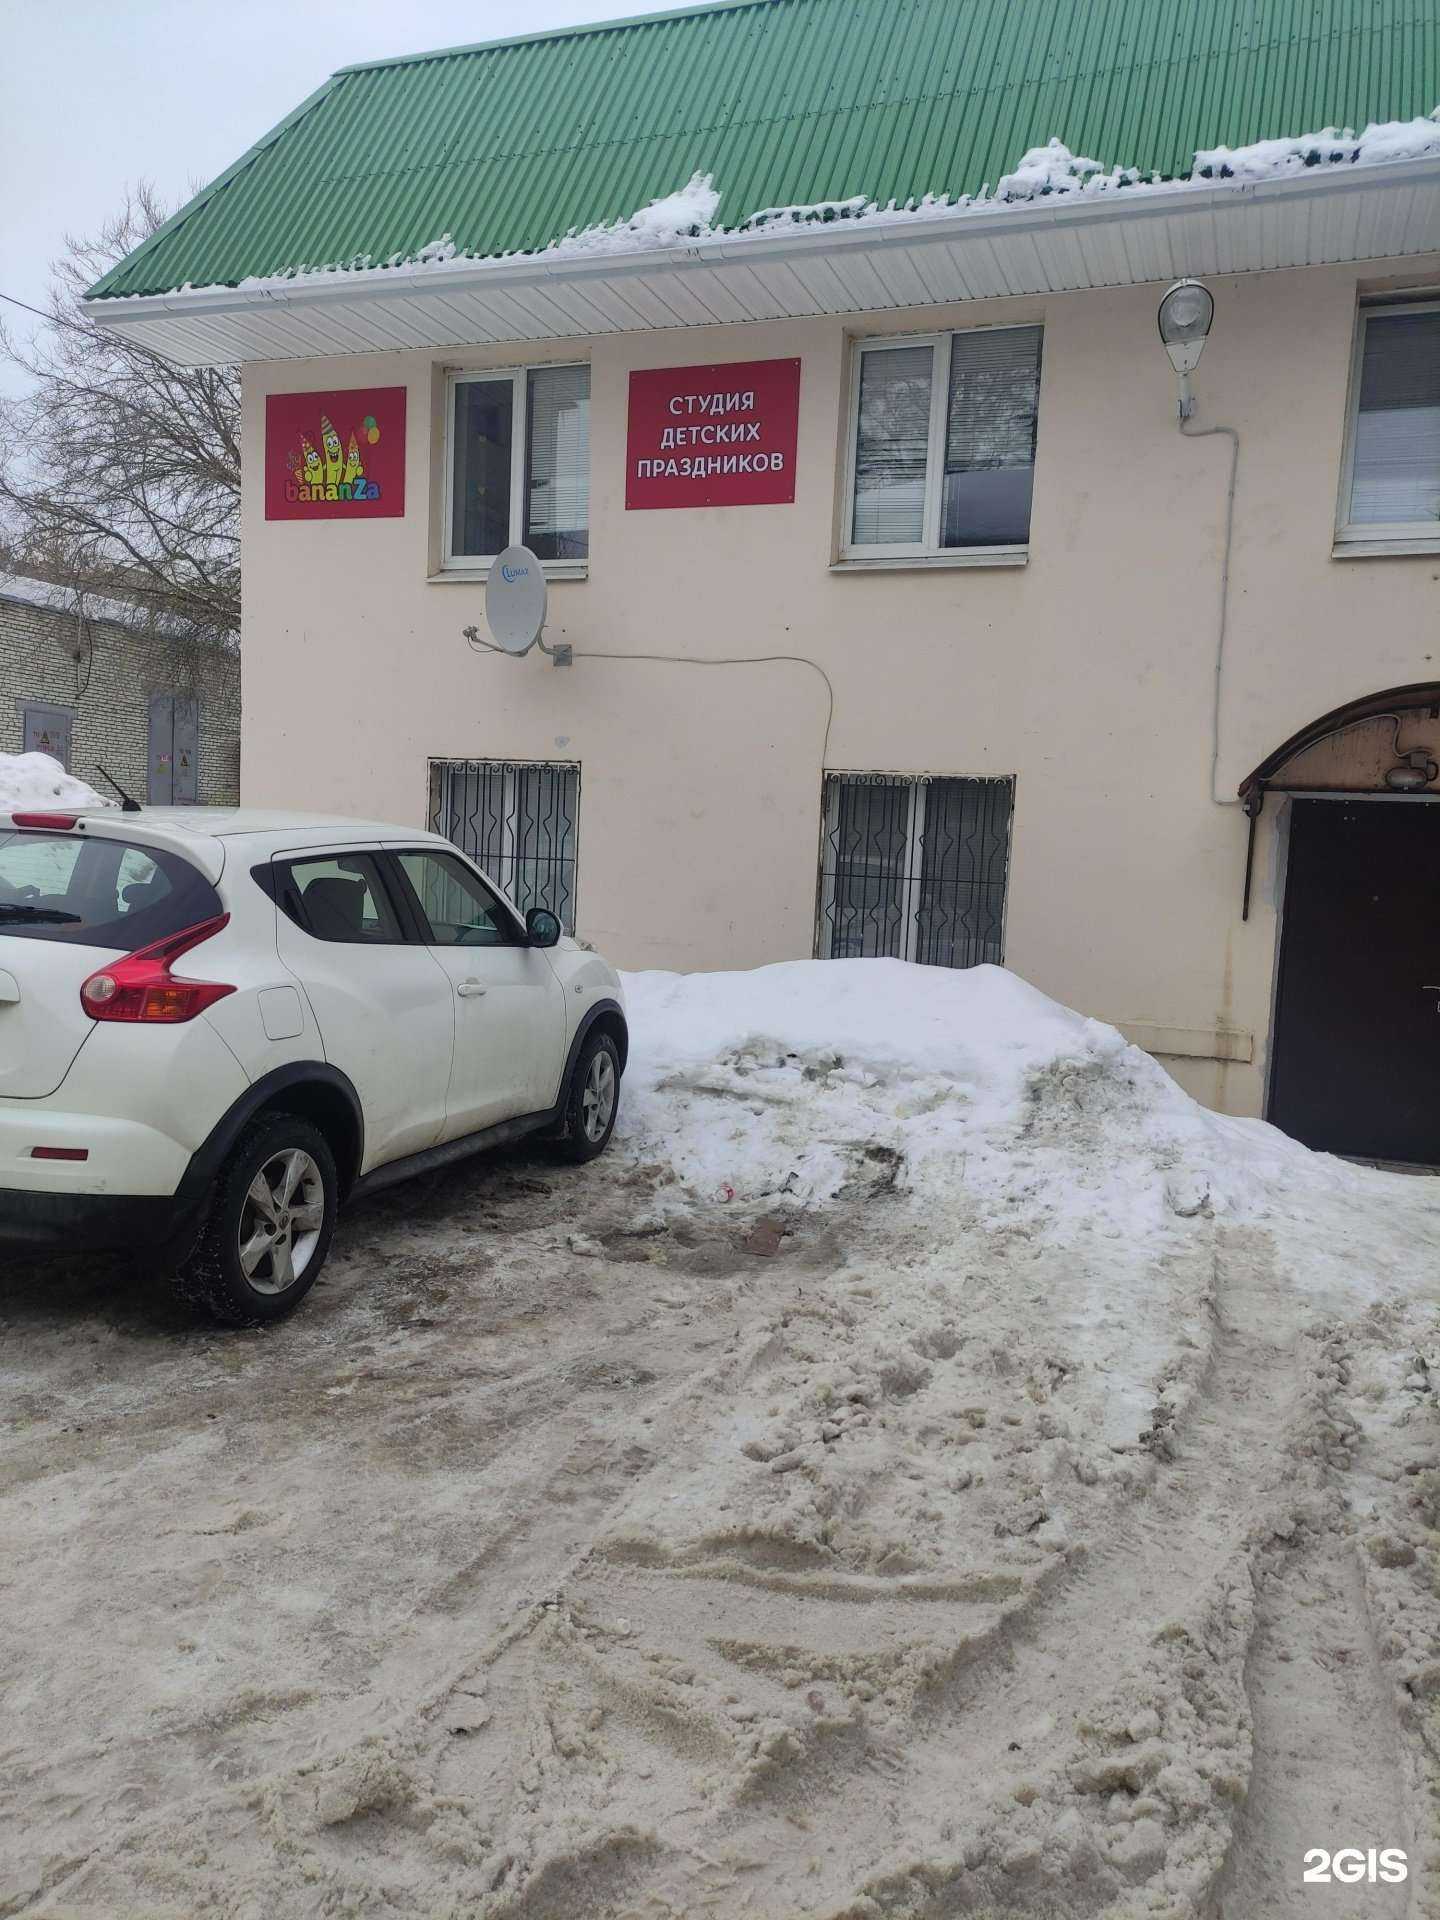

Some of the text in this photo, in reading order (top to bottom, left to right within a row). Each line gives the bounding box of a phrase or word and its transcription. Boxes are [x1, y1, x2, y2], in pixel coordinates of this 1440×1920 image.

[669, 391, 755, 415] СТУДИЯ
[660, 422, 761, 450] ДЕТСКИХ
[637, 453, 784, 479] ПРАЗДНИКОВ
